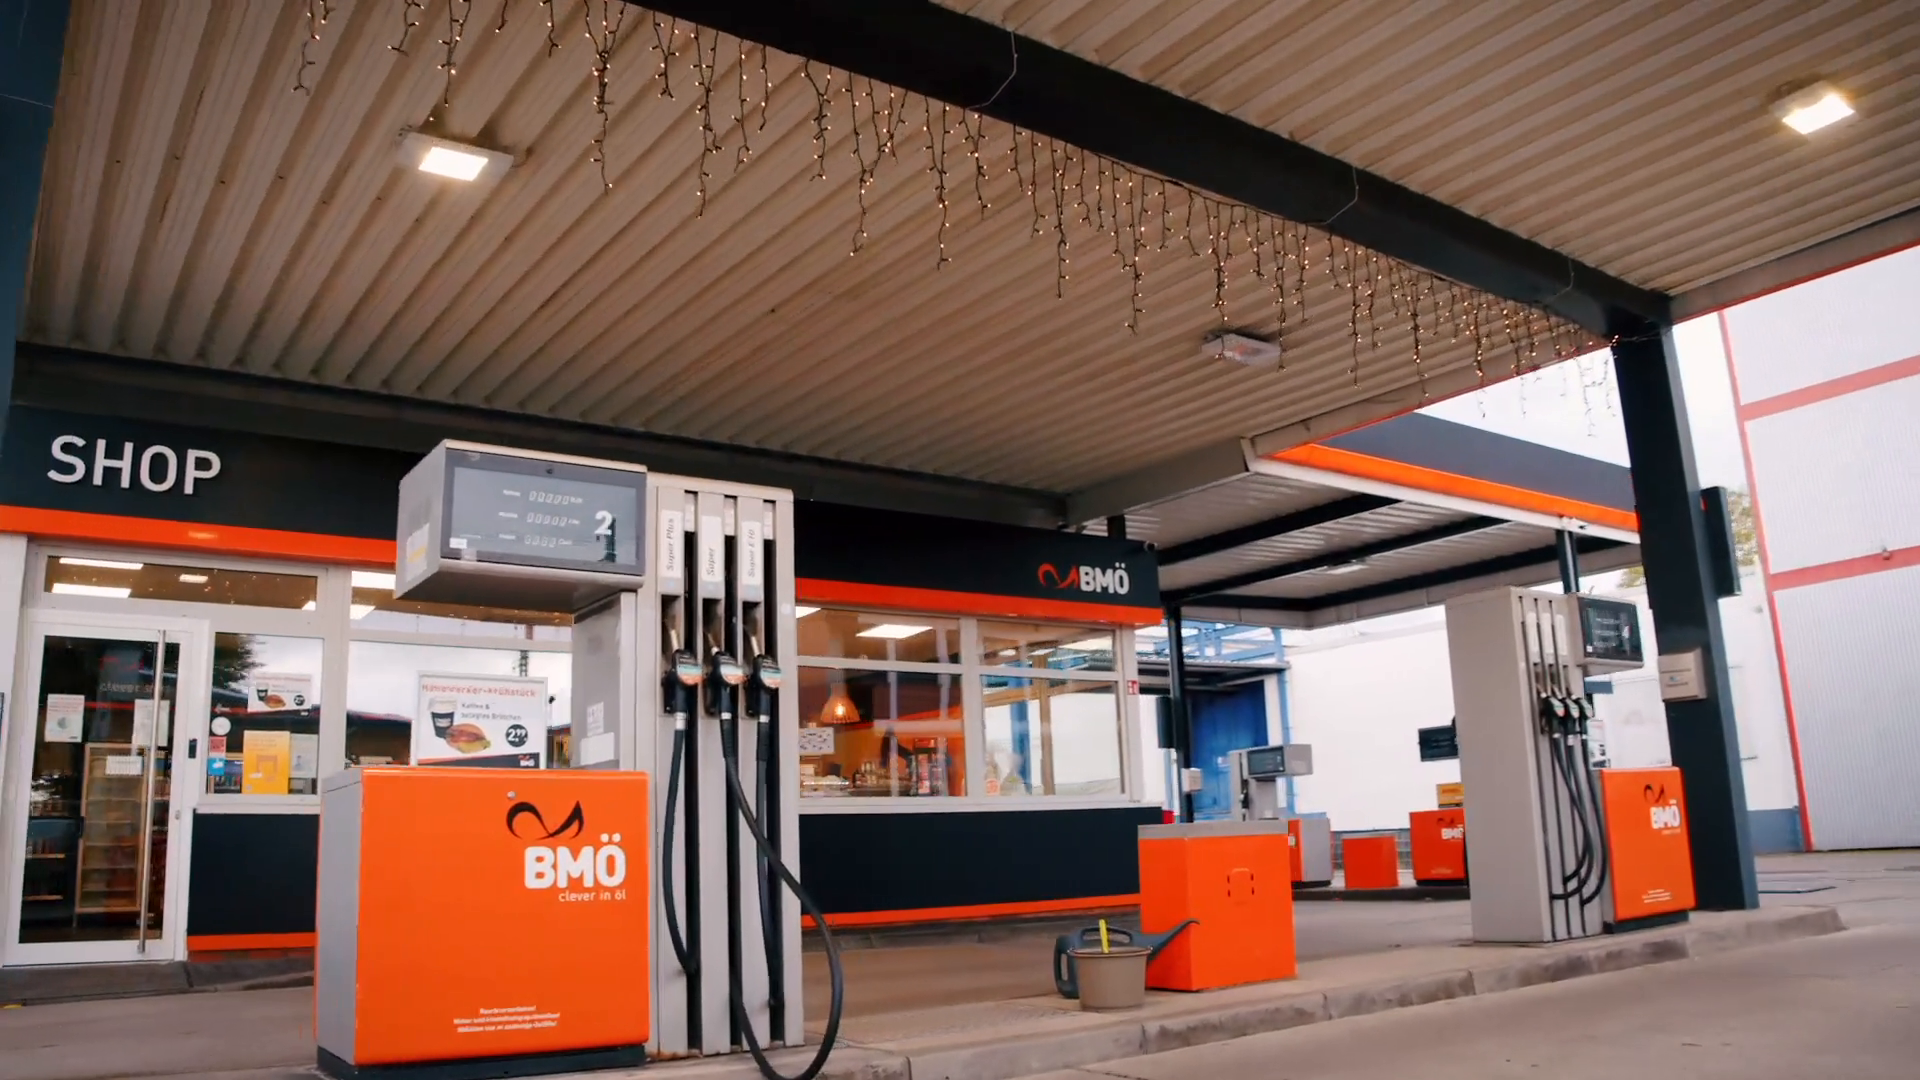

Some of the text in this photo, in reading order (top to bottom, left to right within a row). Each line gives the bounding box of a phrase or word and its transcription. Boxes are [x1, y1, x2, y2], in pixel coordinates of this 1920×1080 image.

[47, 434, 222, 495] SHOP
[594, 510, 613, 535] 2
[666, 518, 675, 571] Super Plus
[706, 547, 716, 576] Super
[747, 550, 756, 578] Super
[1079, 562, 1130, 595] BMÖ
[1650, 798, 1680, 829] BMÖ
[524, 833, 626, 889] BMÖ
[558, 889, 627, 902] clever in öl
